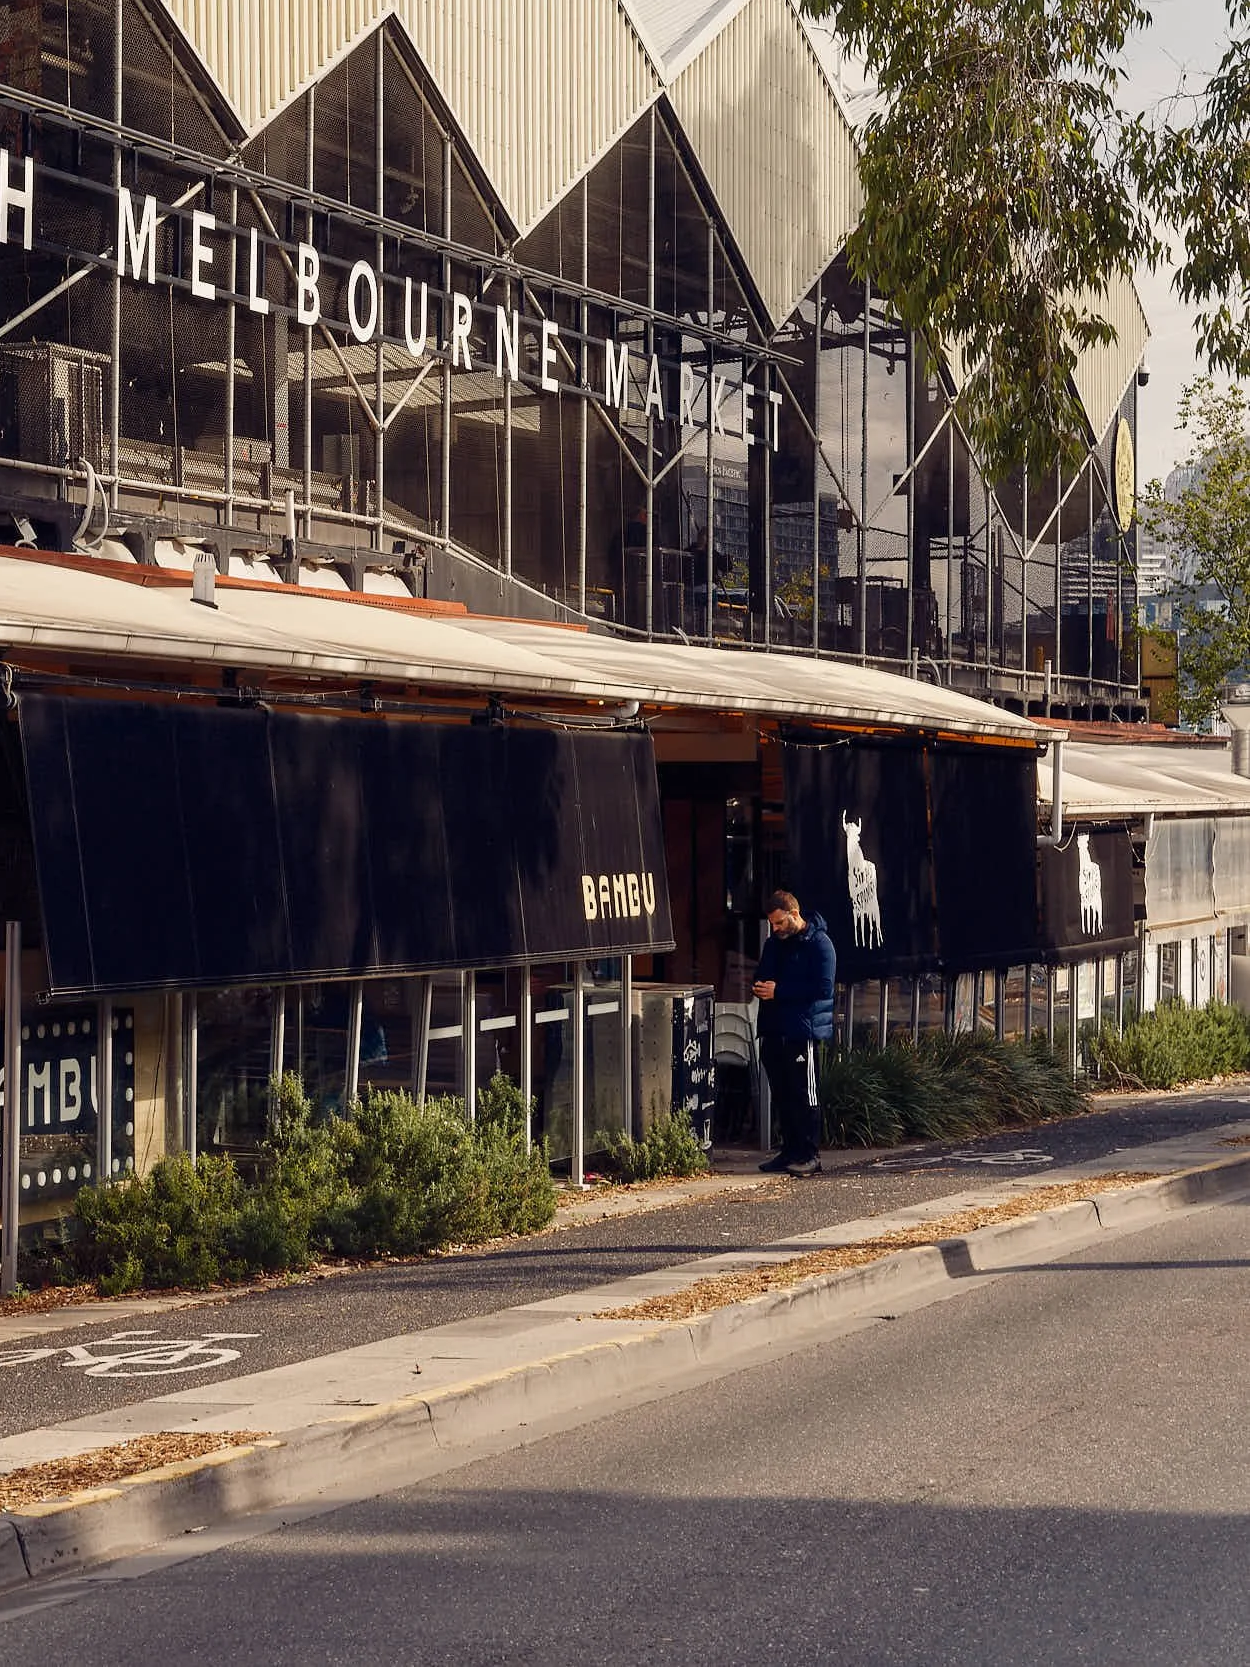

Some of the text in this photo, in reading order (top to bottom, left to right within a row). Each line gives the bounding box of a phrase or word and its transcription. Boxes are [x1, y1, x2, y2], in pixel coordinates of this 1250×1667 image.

[117, 188, 560, 393] MELBOURNE
[605, 338, 783, 453] MARKET
[581, 872, 656, 920] BAMBU
